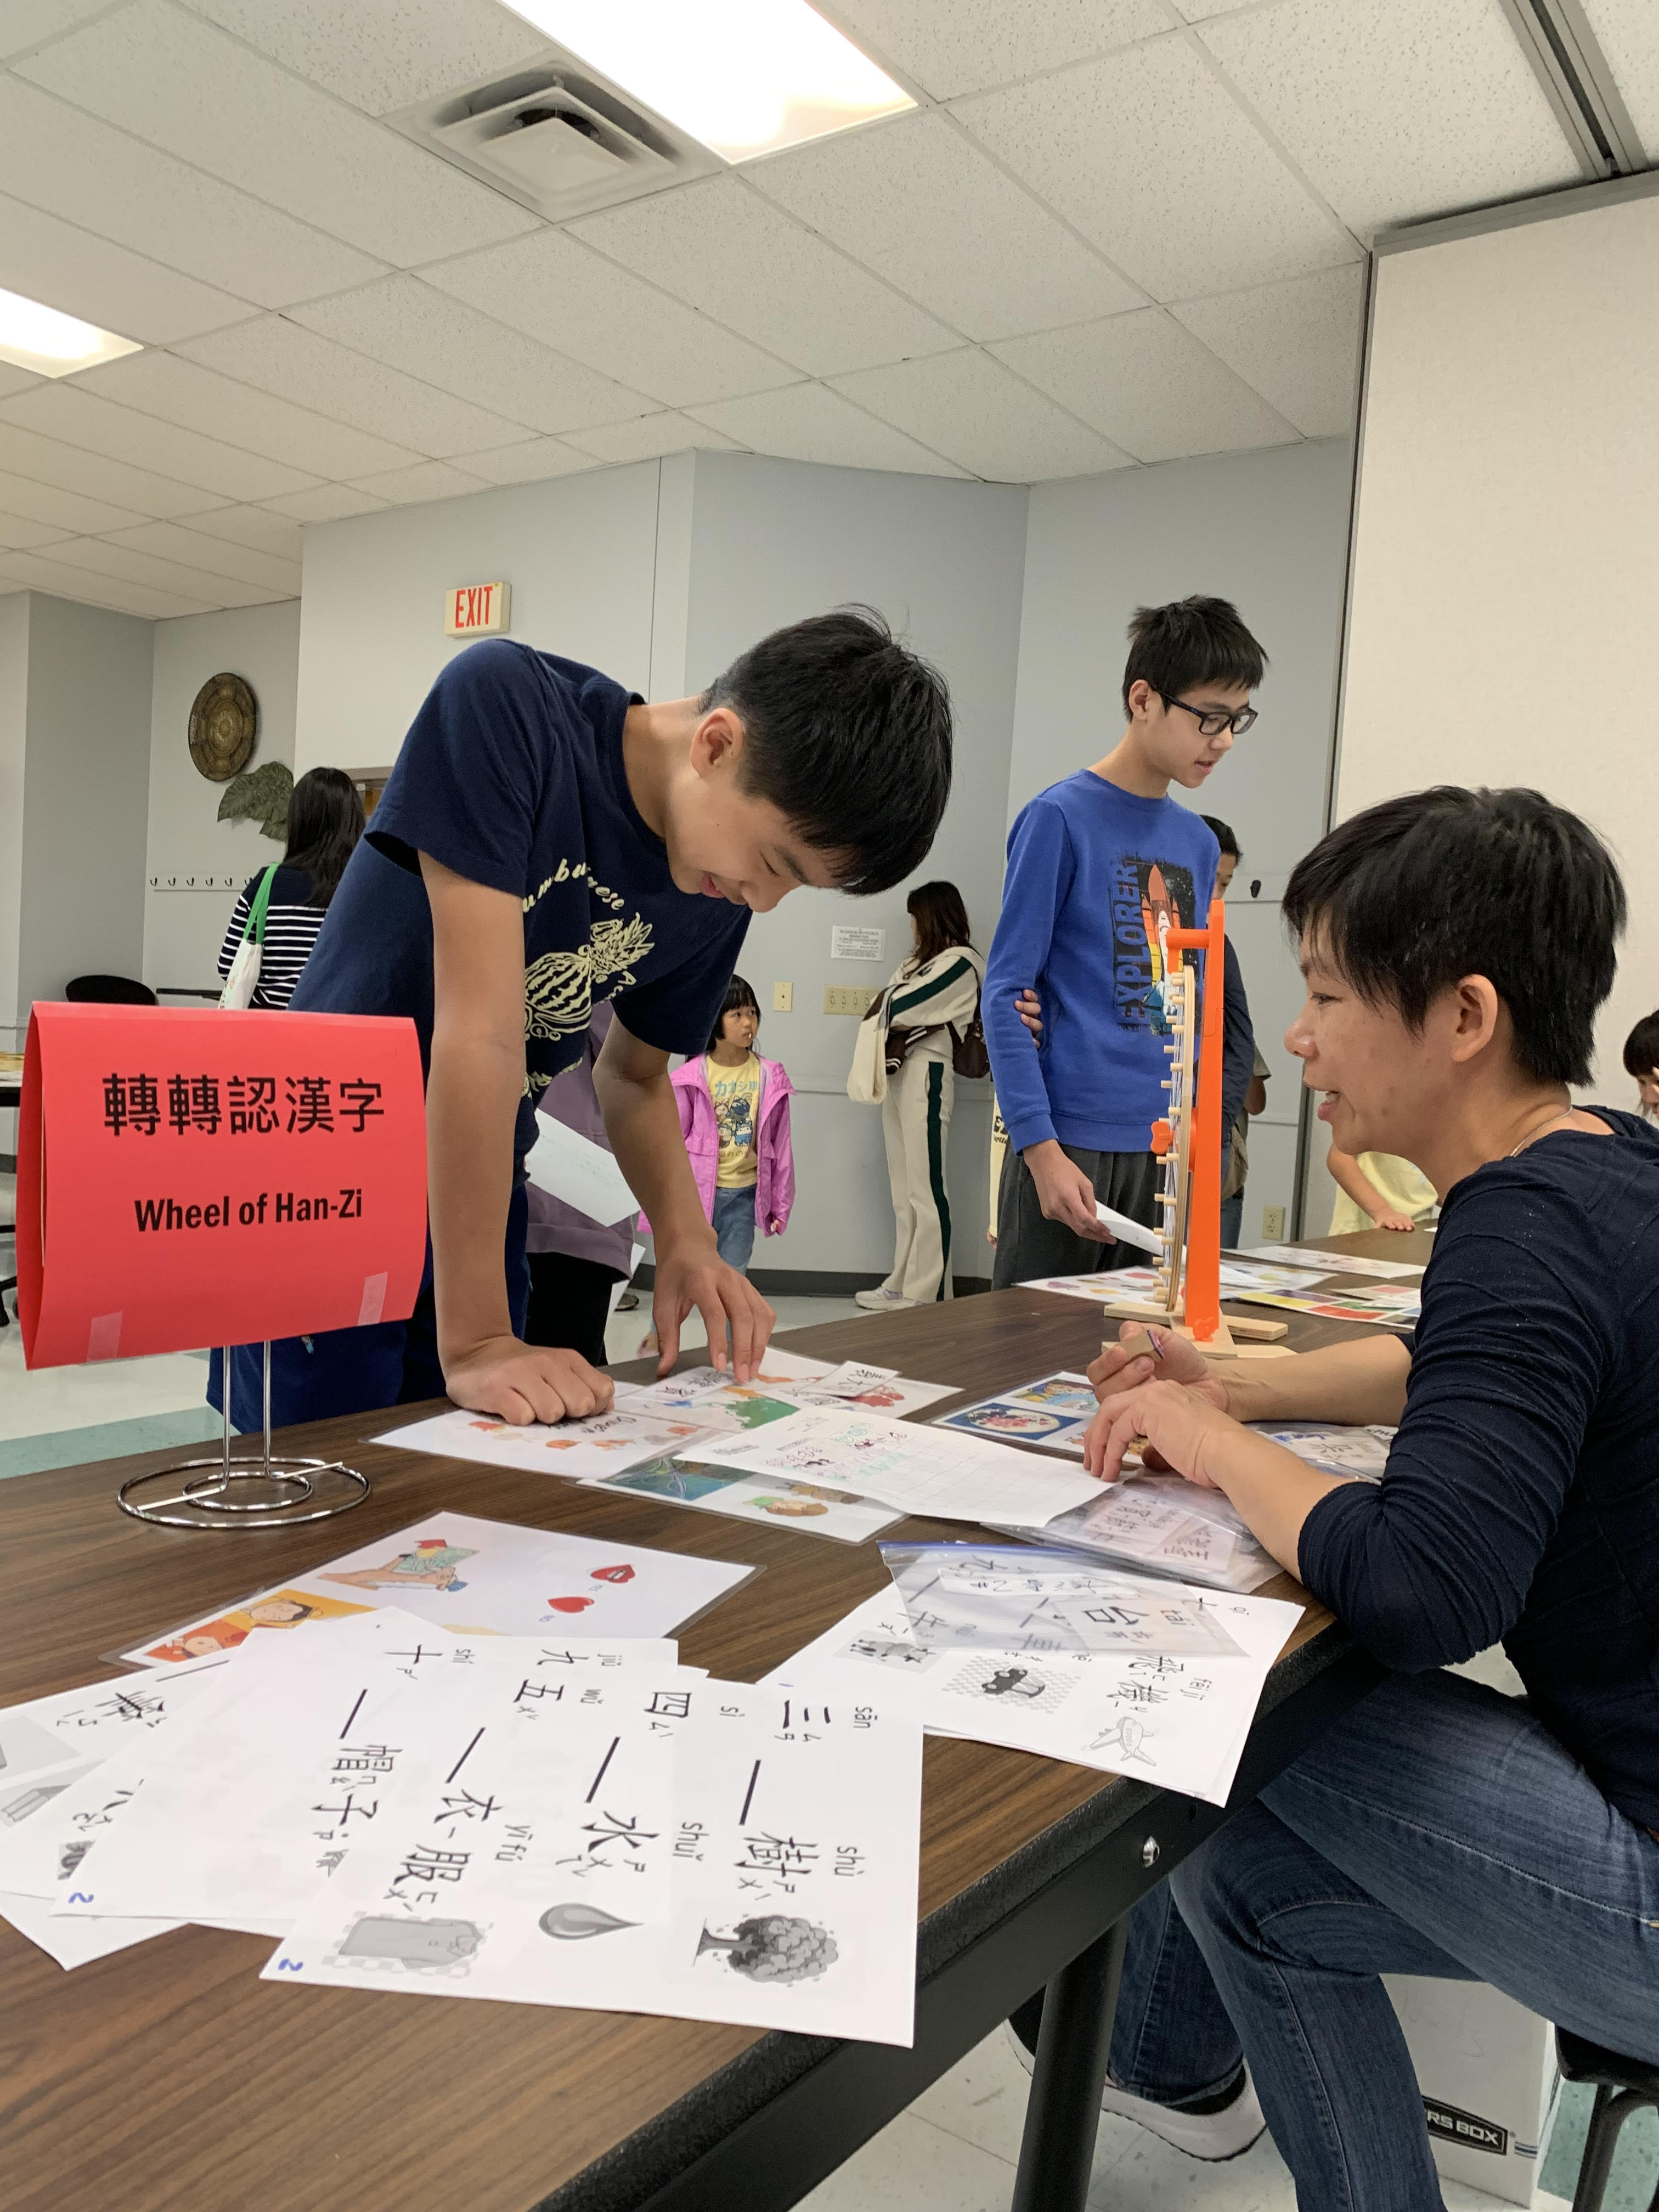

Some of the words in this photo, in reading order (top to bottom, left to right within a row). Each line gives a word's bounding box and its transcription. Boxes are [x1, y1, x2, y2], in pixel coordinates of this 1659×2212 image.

[455, 585, 493, 628] EXIT
[1110, 863, 1153, 1025] EXPLORER
[102, 1073, 385, 1137] 轉轉認漢字
[134, 1195, 230, 1232] Wheel
[239, 1192, 268, 1226] of
[275, 1188, 362, 1223] Han-Zi
[386, 1644, 443, 1665] 十
[537, 1649, 590, 1668] 九
[512, 1679, 565, 1703] 五
[644, 1691, 692, 1719] 四
[782, 1699, 832, 1730] 三
[853, 1706, 878, 1730] sān
[312, 1745, 403, 1826] 帽子
[393, 1788, 503, 1886] 衣服
[580, 1810, 660, 1853] 水
[672, 1821, 709, 1861] shuǐ
[734, 1831, 820, 1878] 樹
[833, 1845, 865, 1877] shù
[1456, 2119, 1499, 2146] BOX
